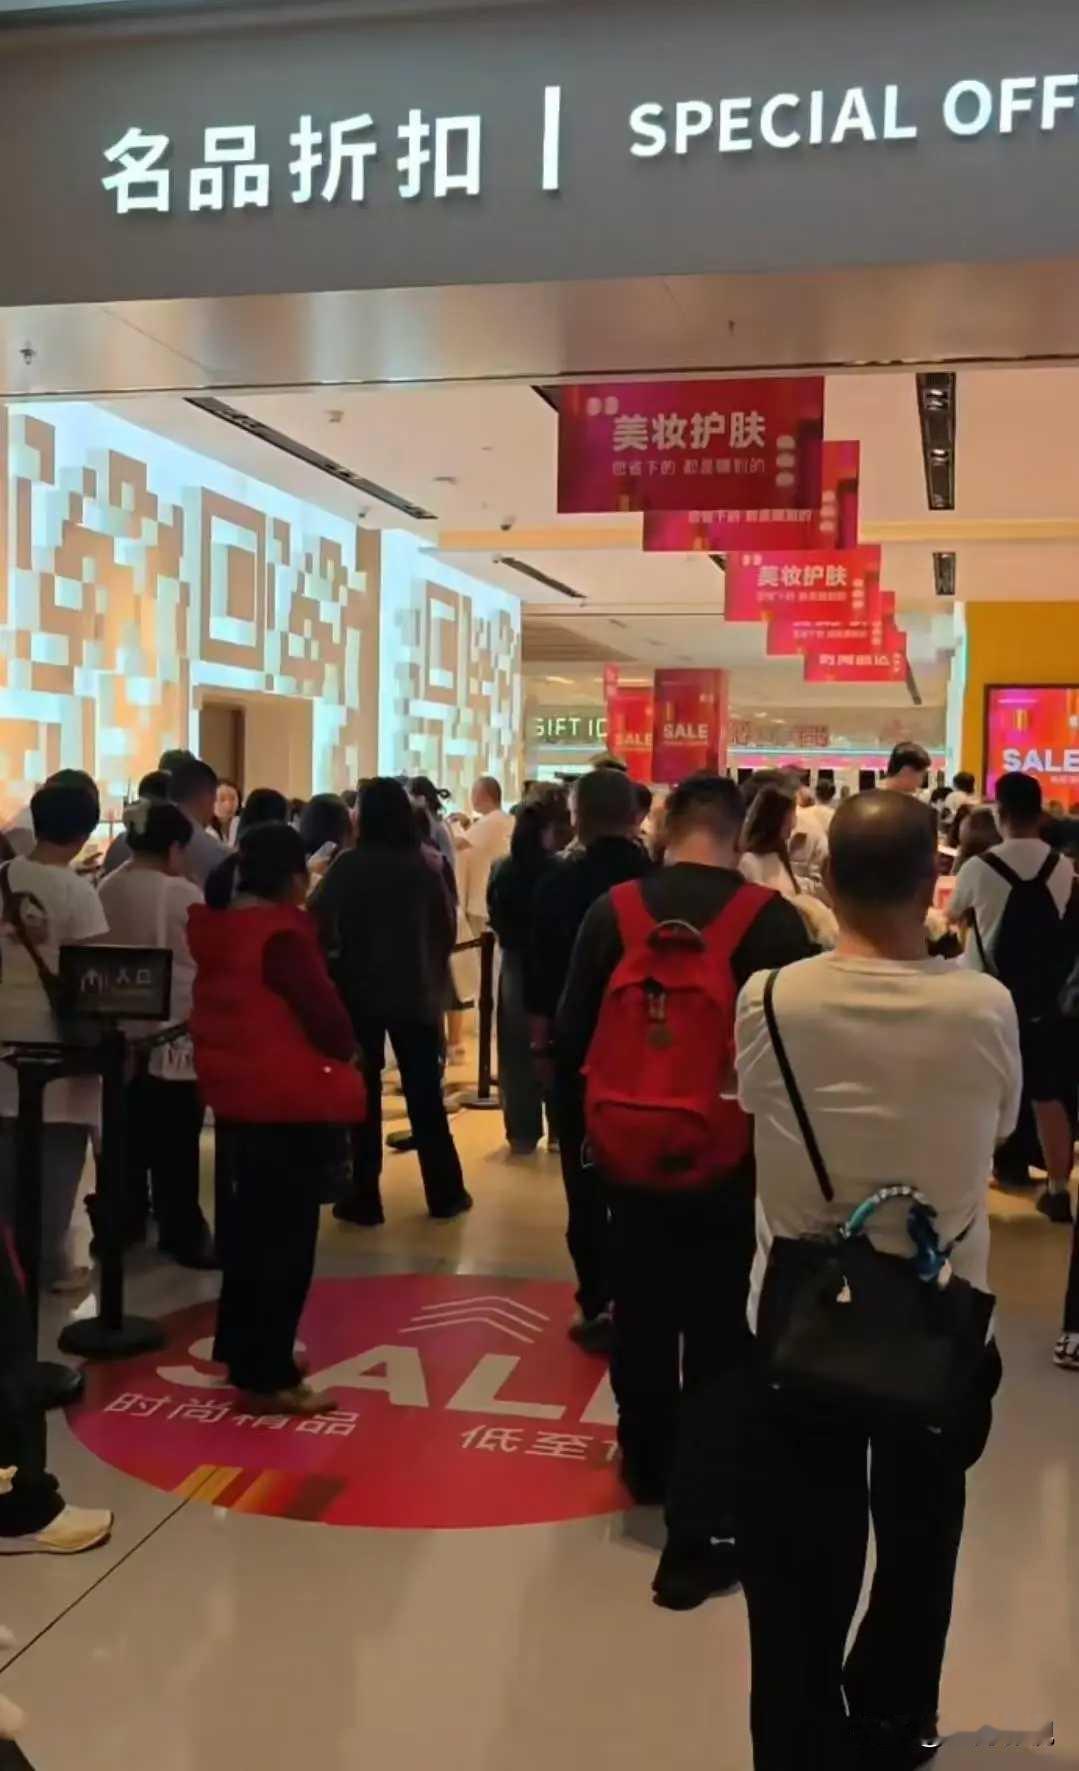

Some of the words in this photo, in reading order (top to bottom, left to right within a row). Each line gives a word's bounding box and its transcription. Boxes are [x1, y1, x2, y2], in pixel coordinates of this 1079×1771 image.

[630, 85, 917, 157] SPECIAL
[942, 74, 1079, 135] OFF
[101, 109, 481, 213] 名品折扣
[613, 411, 766, 451] 美妆护肤
[757, 565, 848, 587] 美妆护肤
[664, 723, 708, 739] SALE
[1002, 748, 1079, 773] SALE
